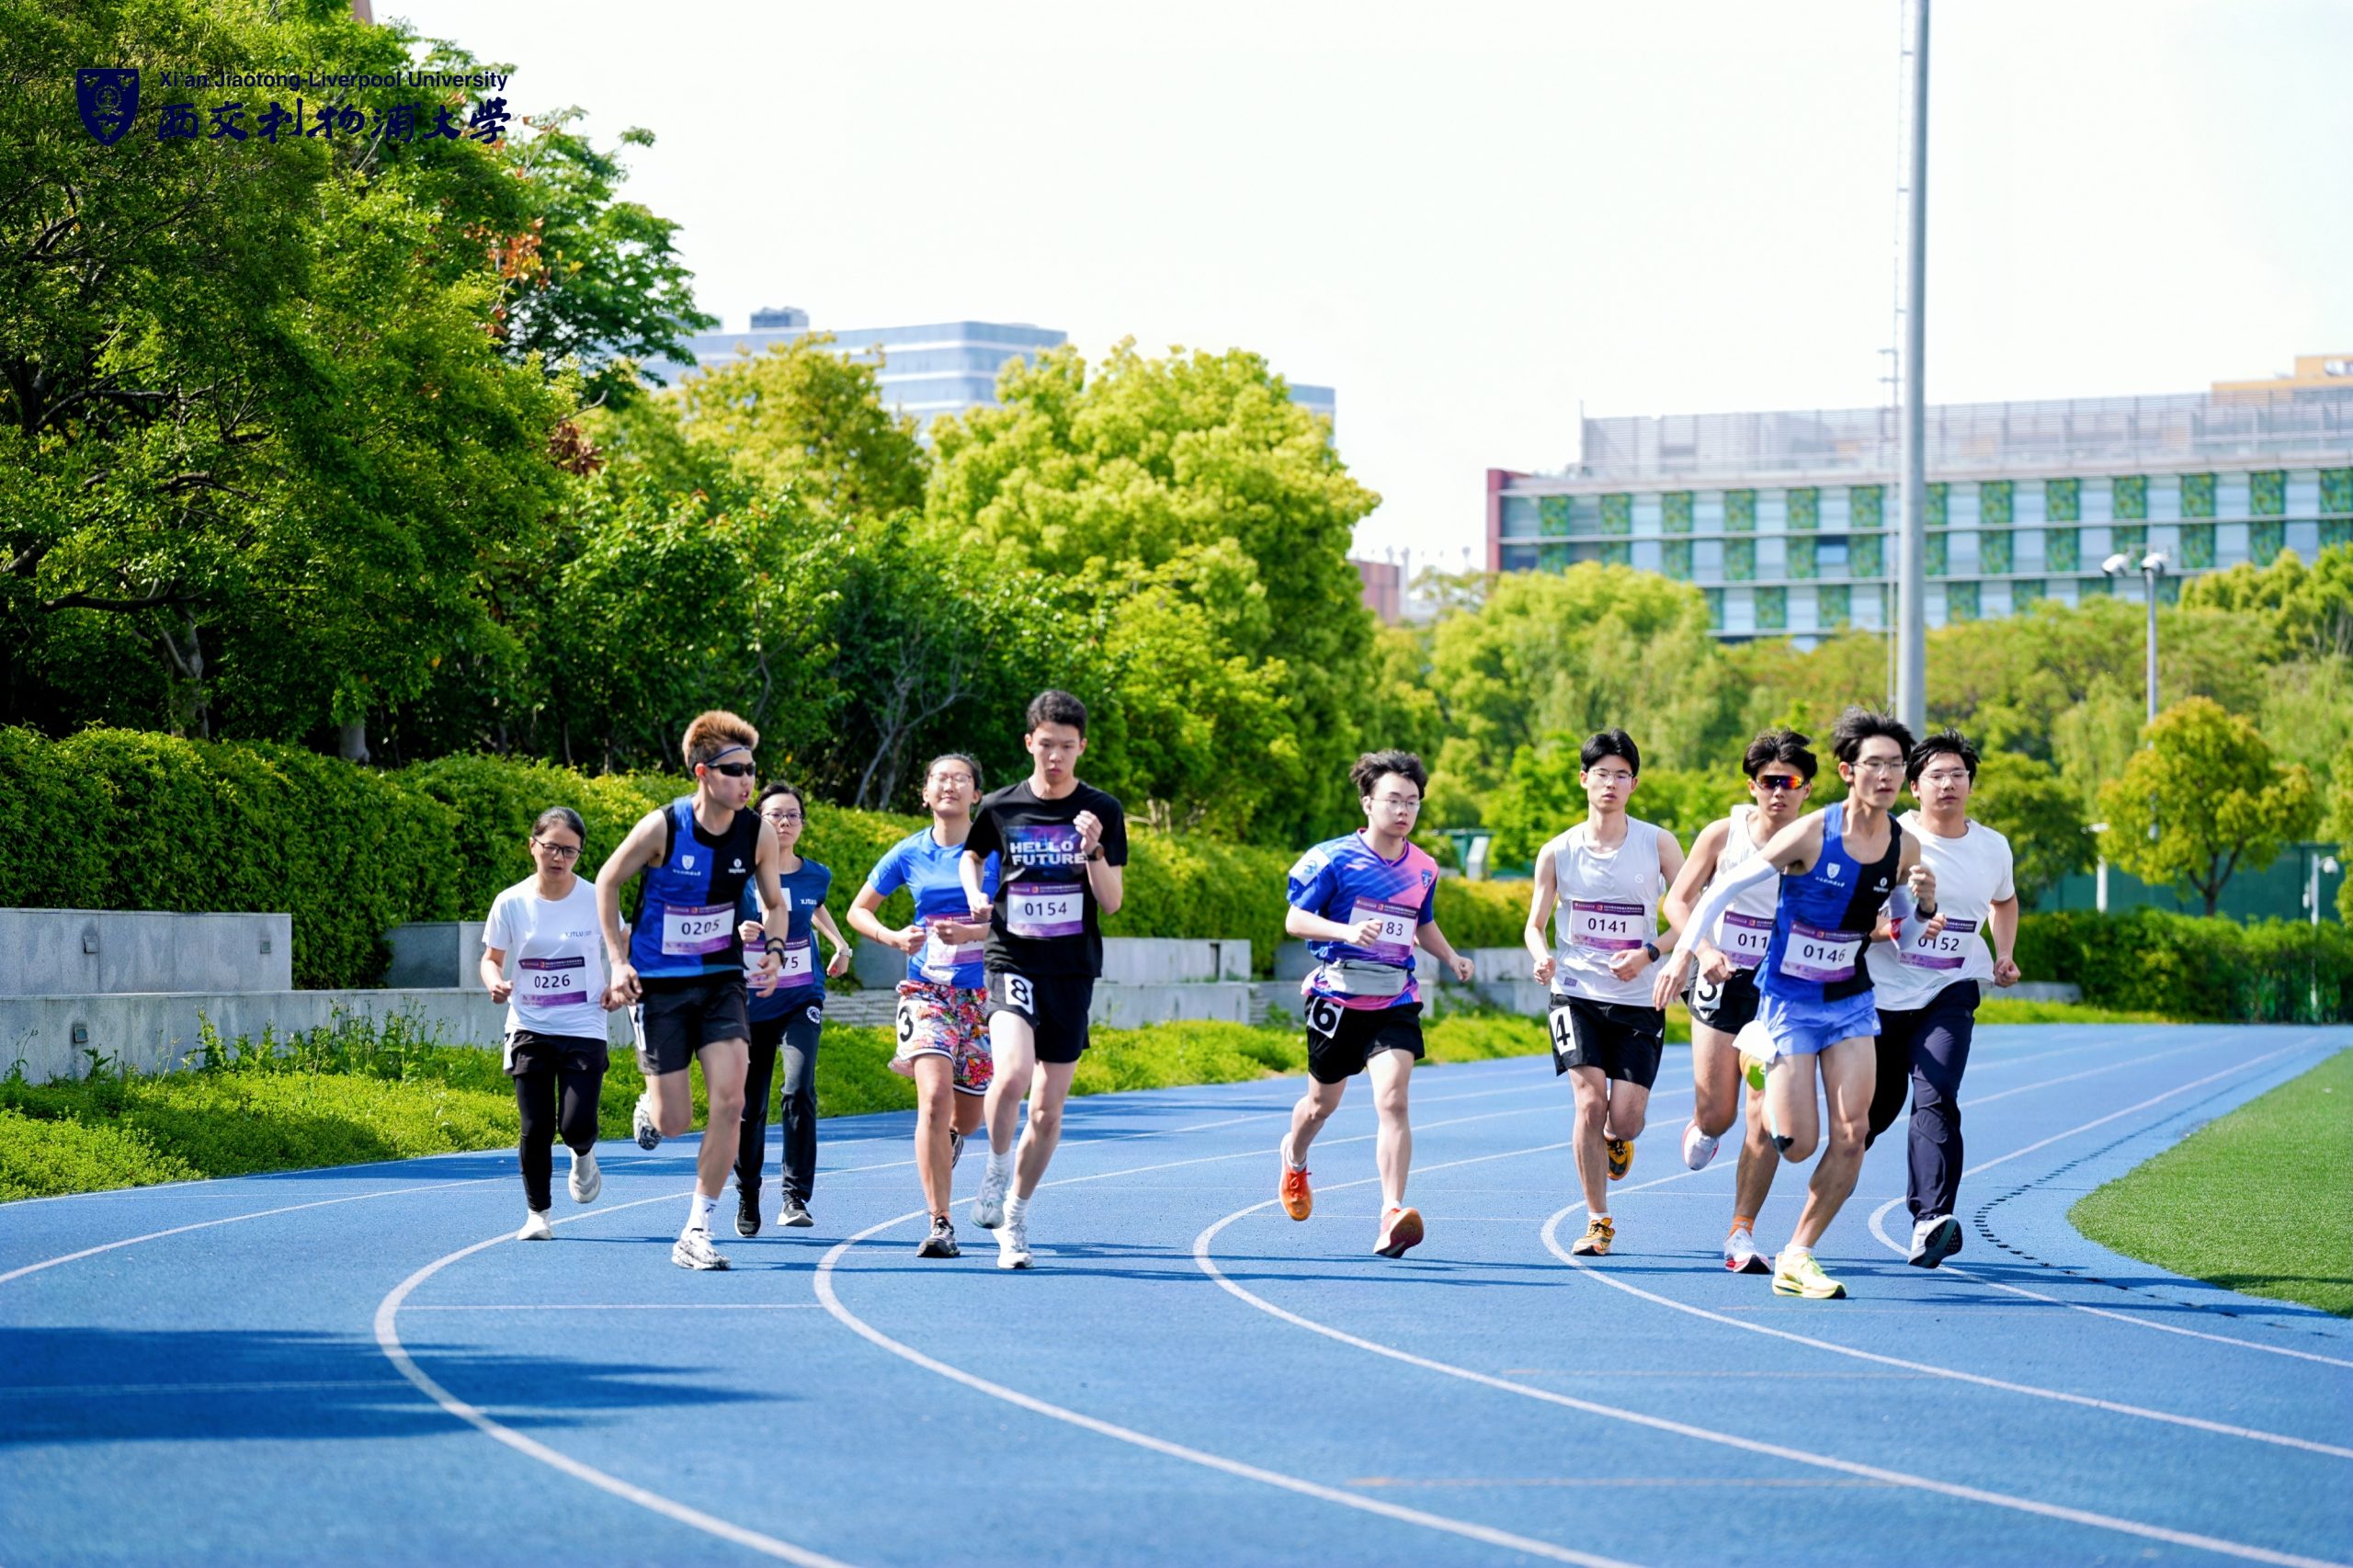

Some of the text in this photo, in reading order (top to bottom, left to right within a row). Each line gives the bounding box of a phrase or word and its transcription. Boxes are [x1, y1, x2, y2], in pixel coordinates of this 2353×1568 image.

[1009, 841, 1074, 853] HELLO
[1012, 853, 1086, 866] FUTURE
[1025, 902, 1067, 916] 0154
[681, 919, 721, 936] 0205
[1587, 917, 1626, 934] 0141
[1737, 933, 1768, 949] 011
[1803, 944, 1847, 963] 0146
[534, 973, 571, 989] 0226
[1010, 979, 1029, 1006] 8
[1313, 997, 1336, 1032] 6
[898, 1006, 914, 1042] 3
[1556, 1014, 1571, 1046] 4
